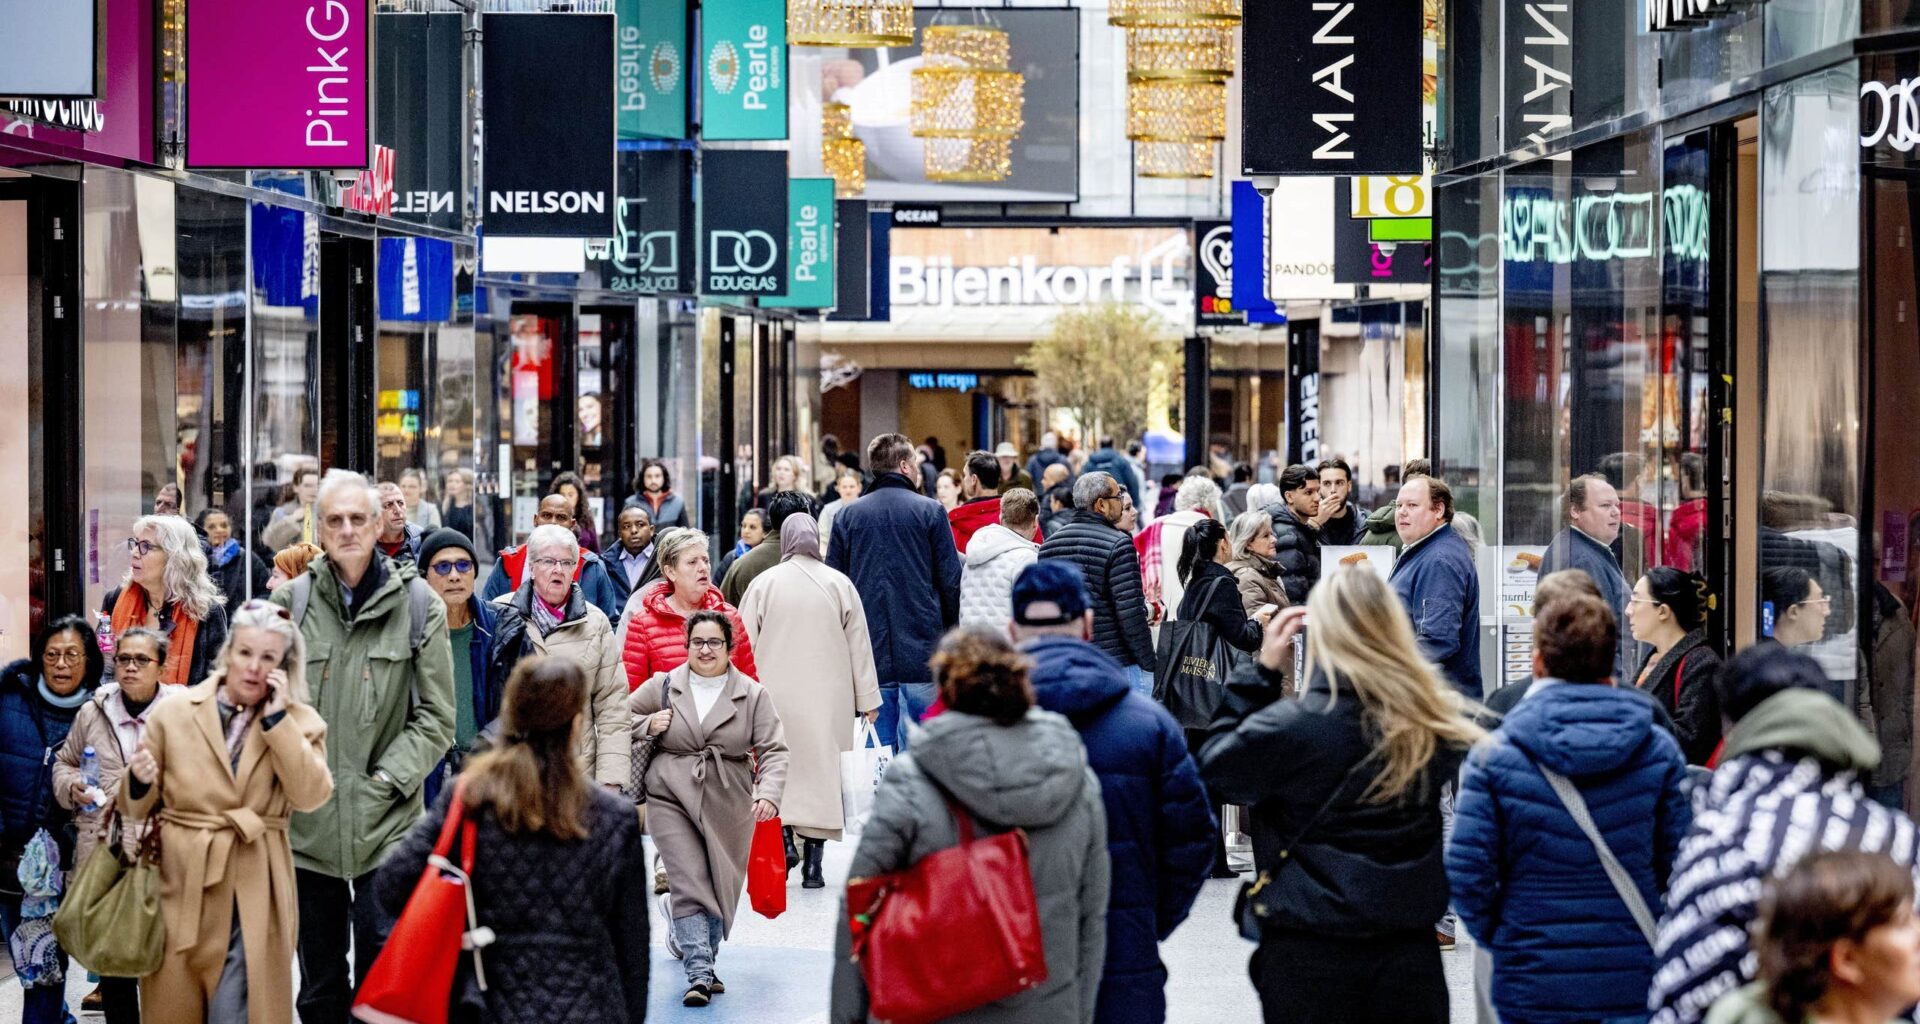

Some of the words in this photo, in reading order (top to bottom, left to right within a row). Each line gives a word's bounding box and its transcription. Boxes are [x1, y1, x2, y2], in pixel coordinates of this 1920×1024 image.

[305, 1, 350, 147] PinkG
[743, 25, 768, 110] Pearle
[1311, 2, 1355, 160] MAN
[490, 191, 605, 213] NELSON
[895, 210, 939, 222] OCEAN
[795, 205, 818, 281] Pearle
[710, 275, 777, 291] DOUGLAS
[890, 255, 1131, 315] Bijenkorf
[1181, 665, 1216, 680] MAISON
